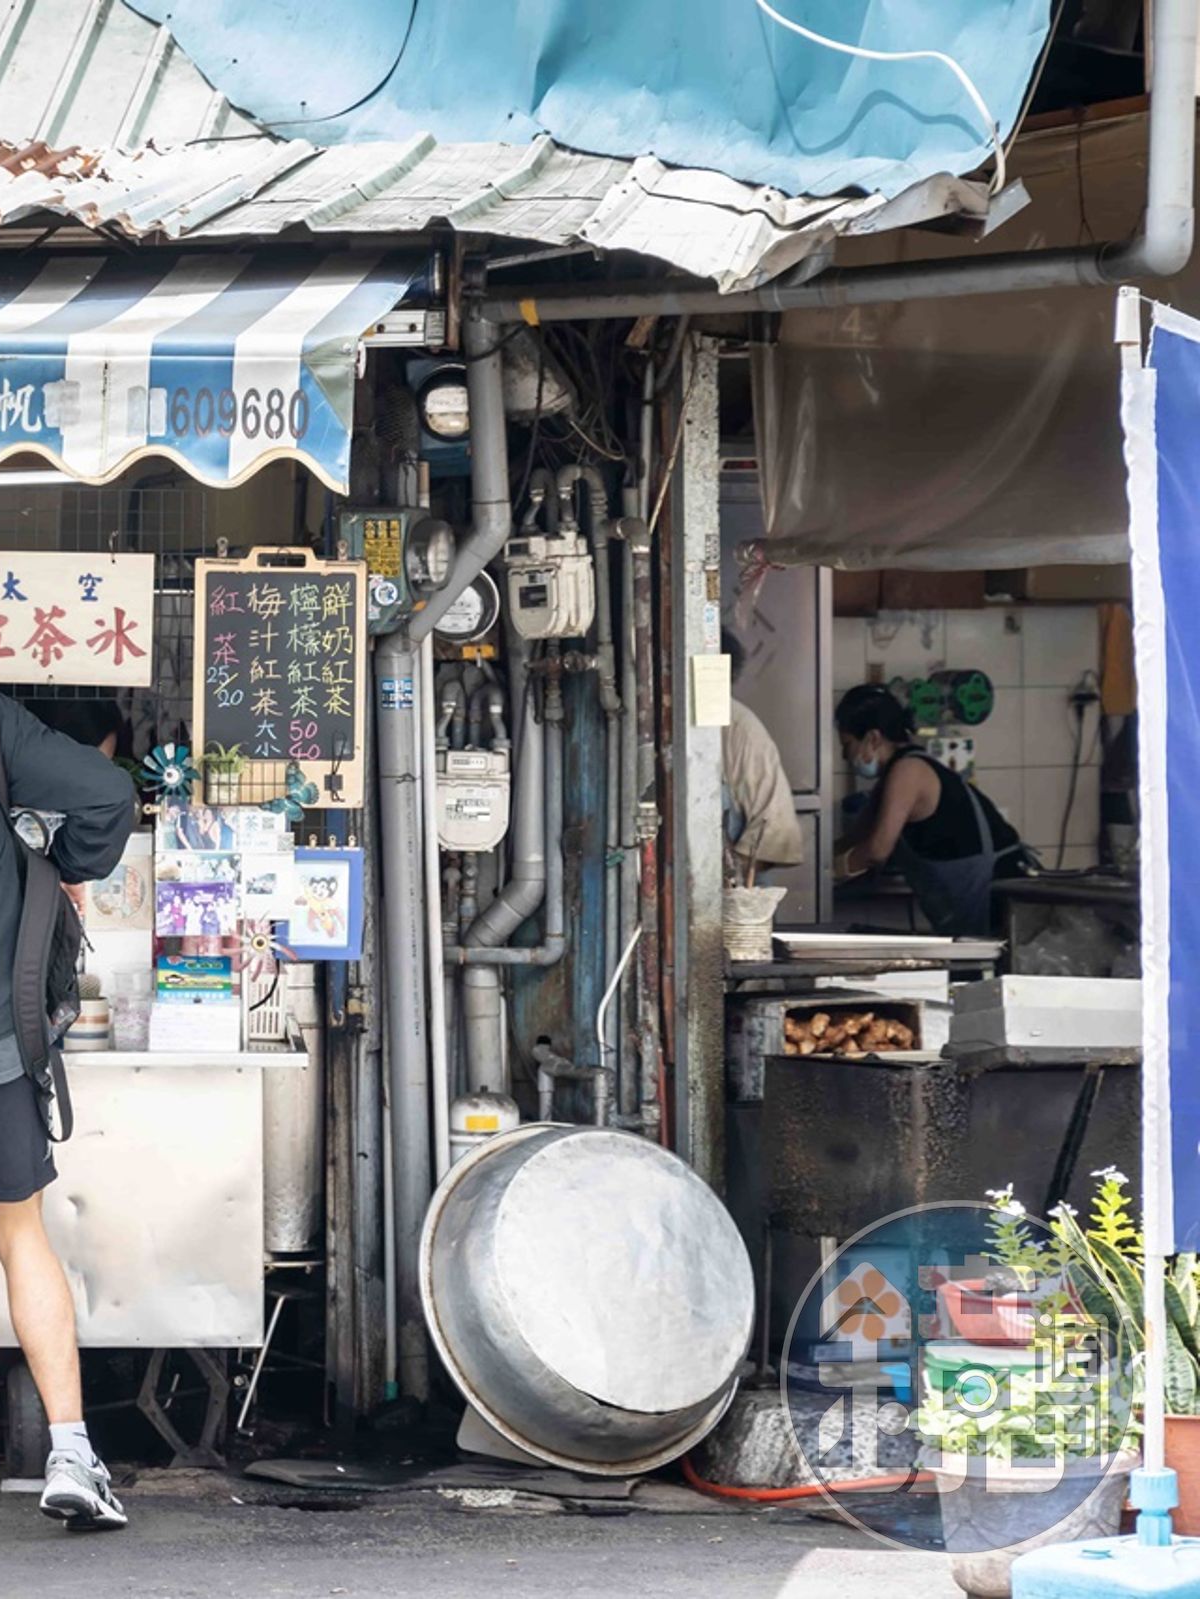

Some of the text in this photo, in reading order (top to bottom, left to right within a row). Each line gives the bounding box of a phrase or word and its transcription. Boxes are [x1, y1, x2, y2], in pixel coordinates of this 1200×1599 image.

[2, 571, 103, 602] 太空
[209, 584, 246, 665] 紅茶
[246, 582, 286, 716] 梅汁紅茶
[286, 582, 321, 718] 檸檬紅茶
[254, 741, 281, 757] 小
[289, 719, 318, 741] 50
